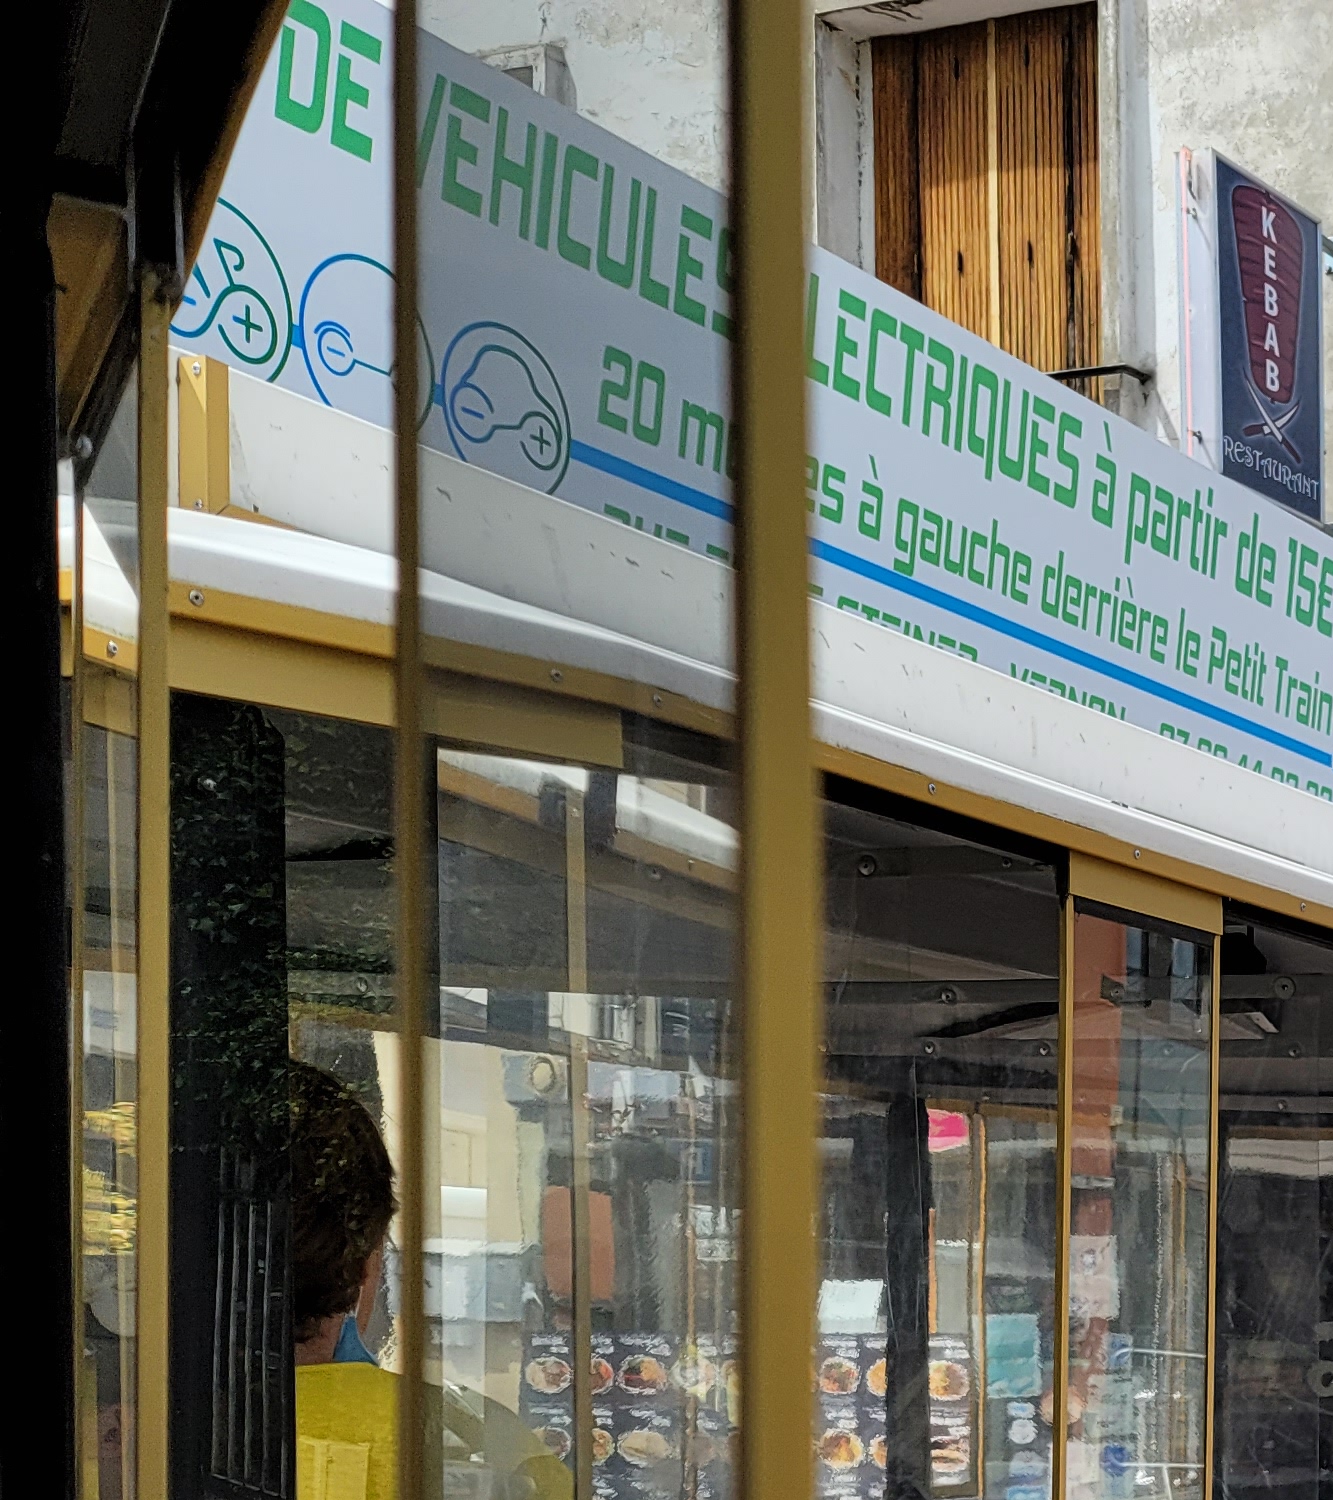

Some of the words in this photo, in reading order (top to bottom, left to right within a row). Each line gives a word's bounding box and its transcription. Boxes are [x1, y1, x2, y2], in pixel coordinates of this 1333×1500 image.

[274, 0, 382, 163] DE
[804, 272, 1082, 510] LECTRIQUES
[1091, 421, 1116, 529] à
[1124, 472, 1228, 580] partir
[1235, 513, 1277, 608] de
[1261, 205, 1280, 393] KEBAB
[597, 345, 666, 447] 20
[858, 454, 883, 541] à
[894, 497, 1032, 605] gauche
[1041, 550, 1168, 664] derrière
[1176, 607, 1201, 678] le
[1207, 625, 1267, 707] Petit
[1275, 656, 1333, 736] Train
[1223, 435, 1320, 499] RESTAURANT
